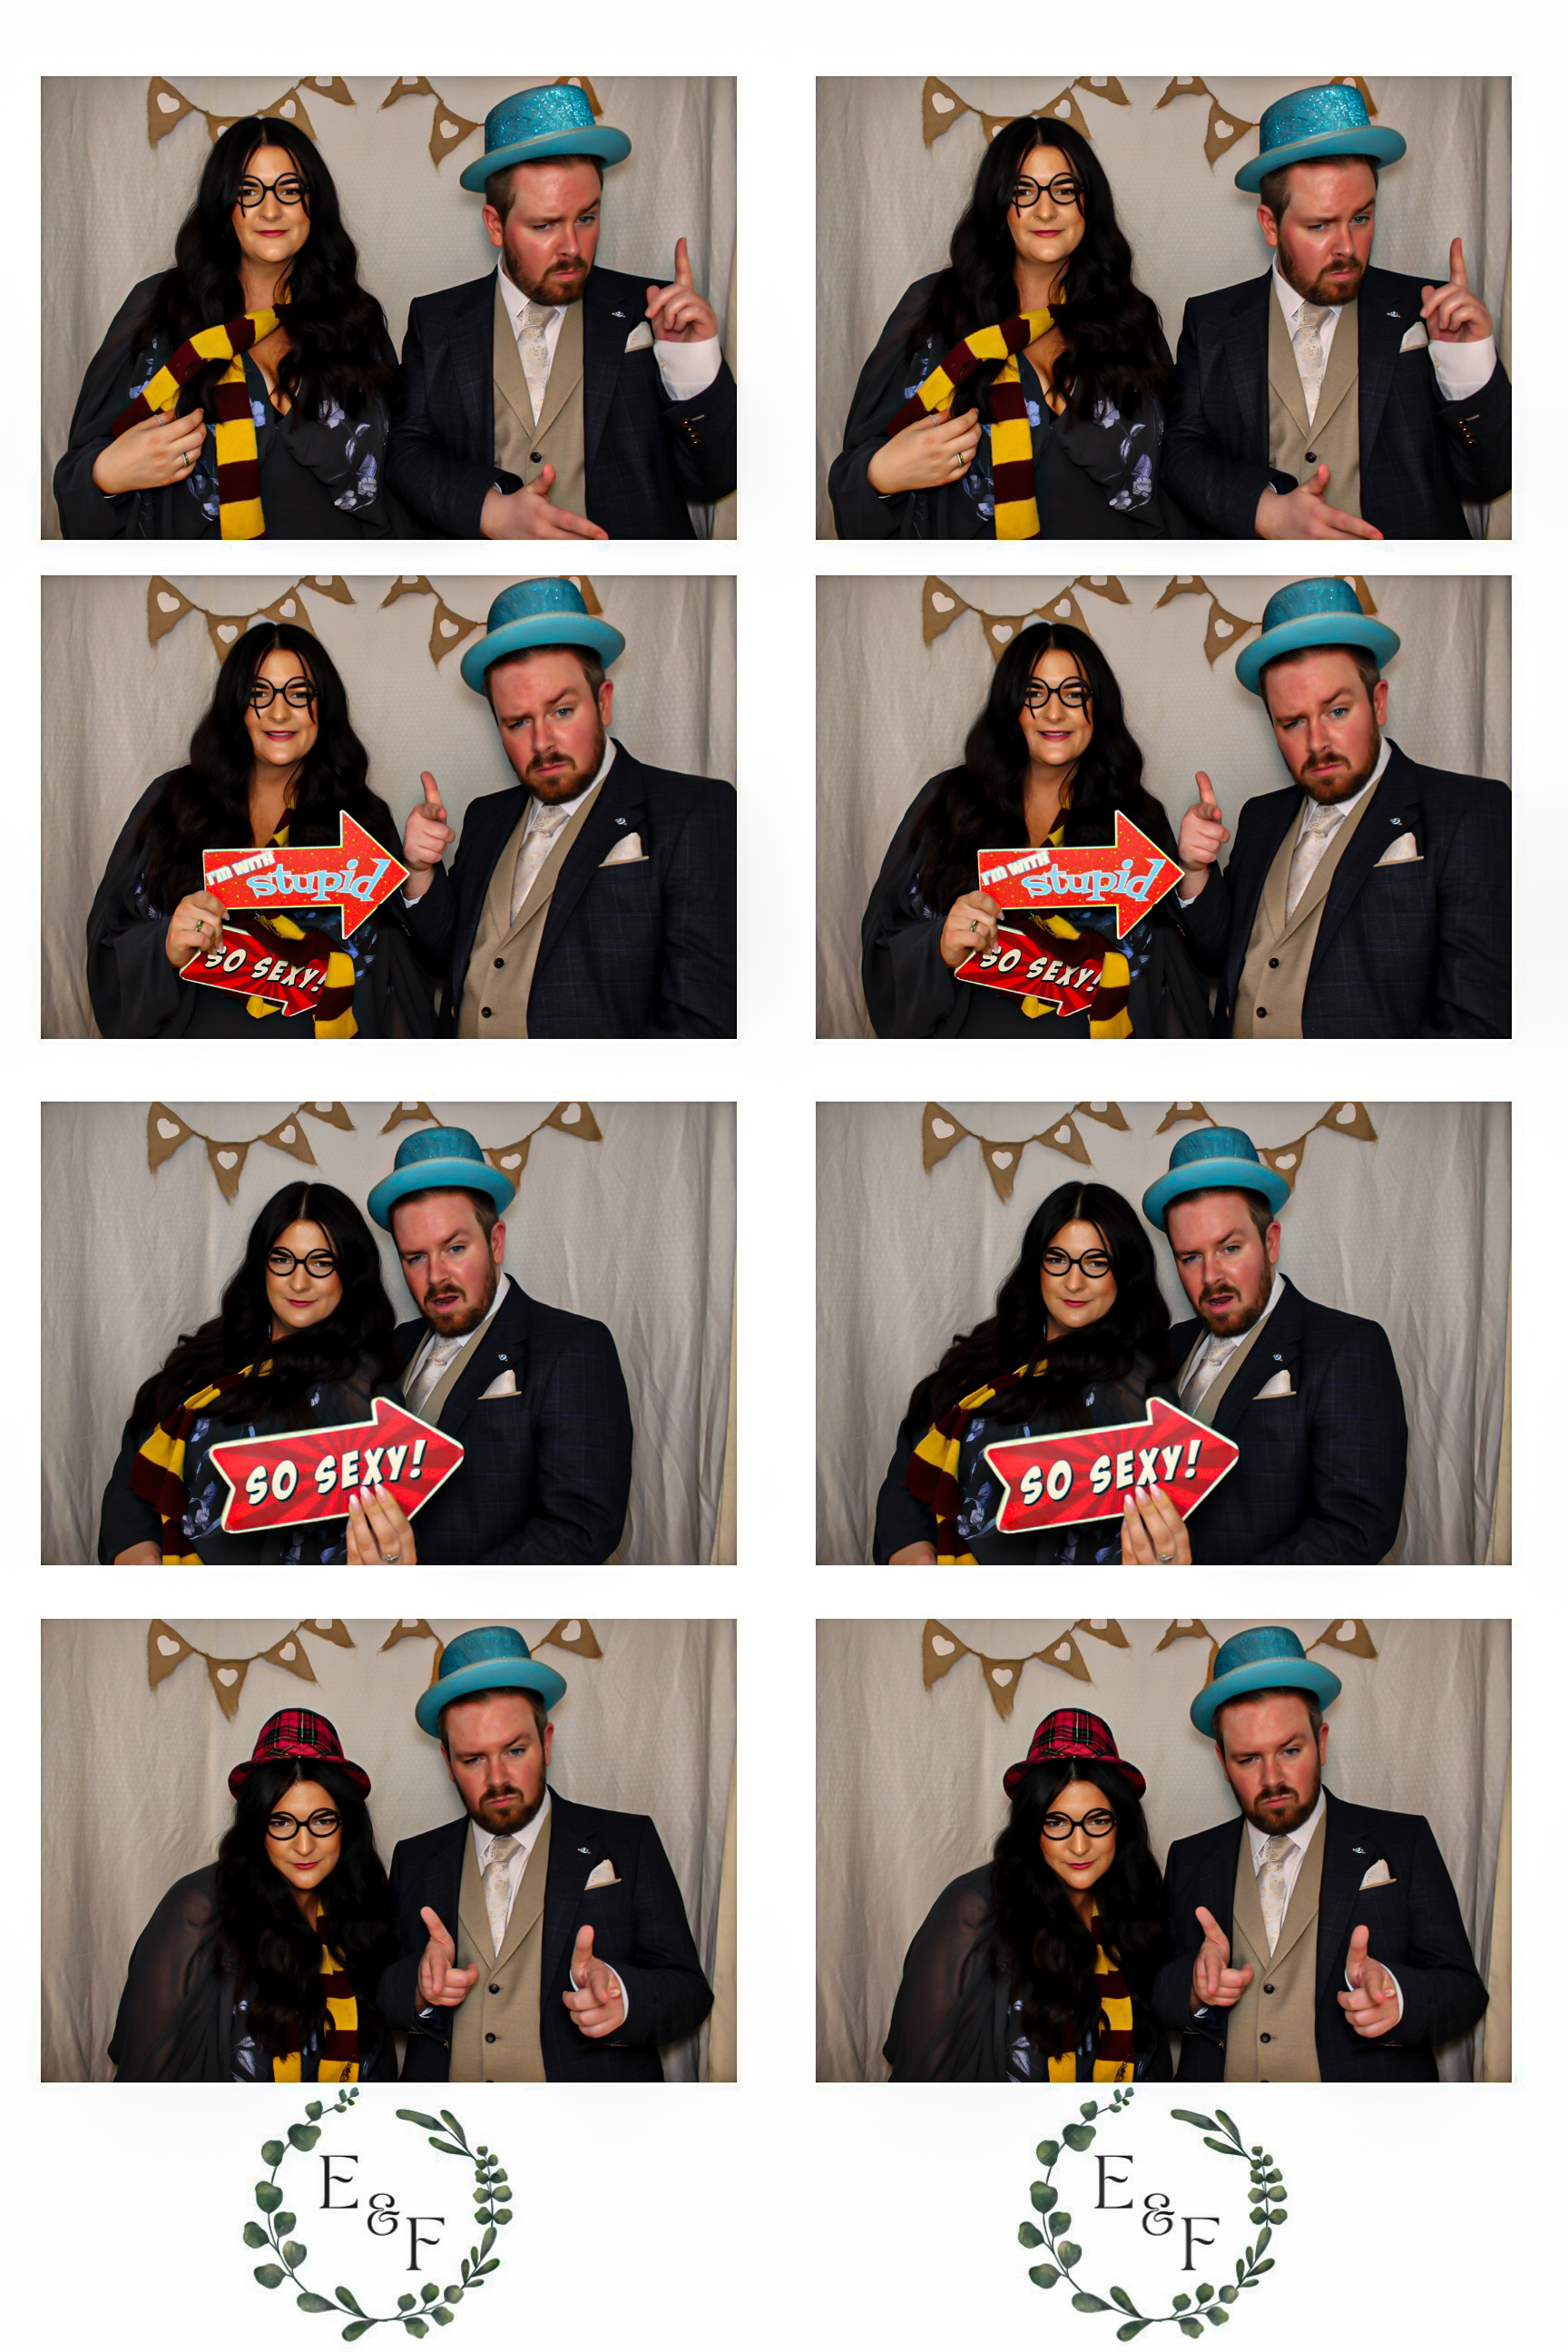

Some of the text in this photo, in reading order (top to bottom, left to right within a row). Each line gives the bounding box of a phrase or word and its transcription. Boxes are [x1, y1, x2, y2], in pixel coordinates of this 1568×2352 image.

[231, 850, 276, 877] WITH
[246, 858, 391, 902] stupid
[1006, 850, 1051, 877] WITH
[1021, 858, 1166, 902] stupid
[204, 946, 247, 973] SO
[979, 946, 1022, 973] SO
[245, 1439, 427, 1505] SO SEXY!
[1020, 1439, 1202, 1505] SO SEXY!
